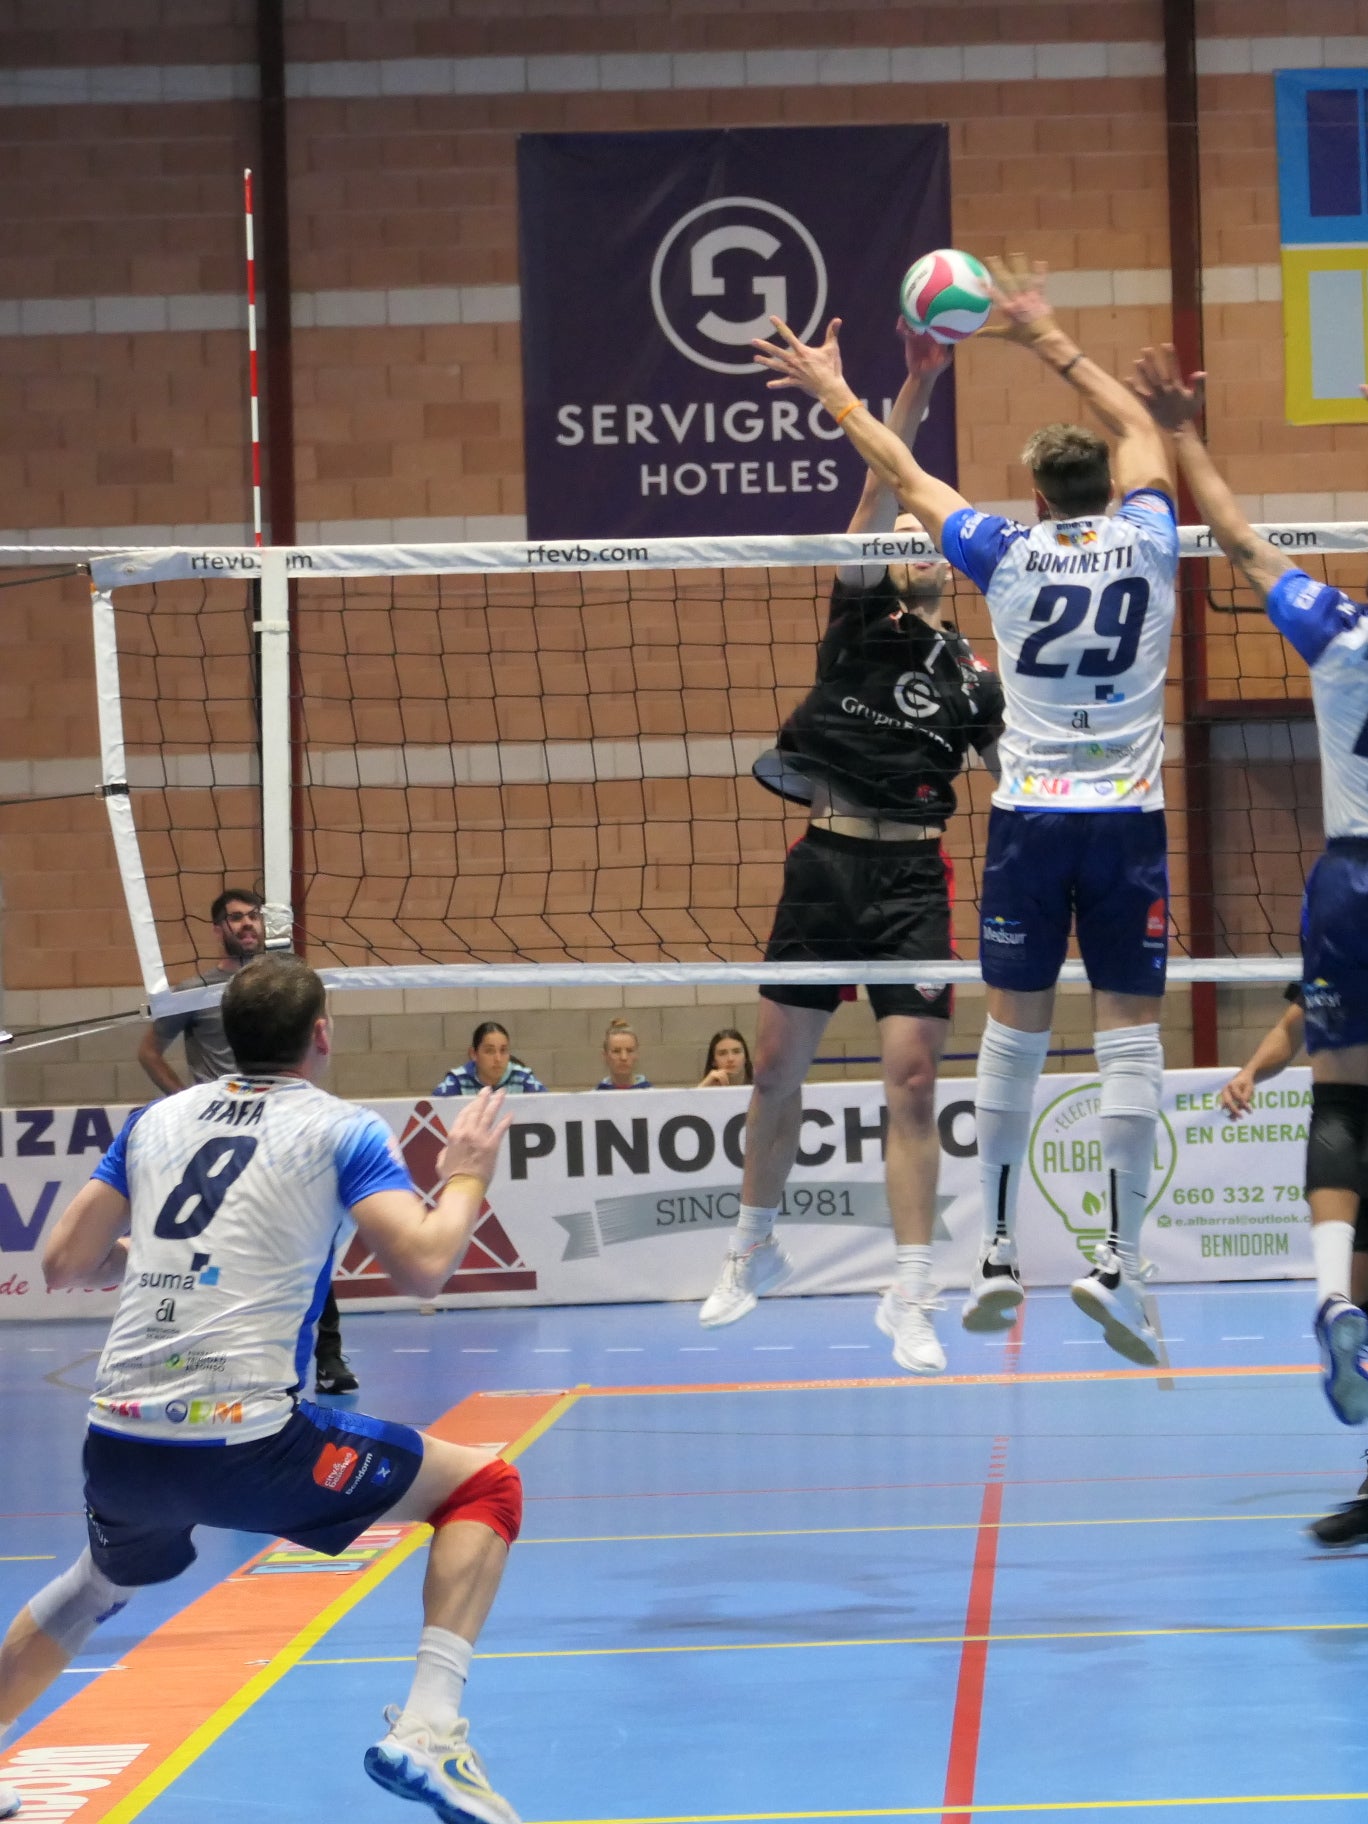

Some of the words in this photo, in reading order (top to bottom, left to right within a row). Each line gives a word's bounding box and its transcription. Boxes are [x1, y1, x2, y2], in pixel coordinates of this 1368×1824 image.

[556, 398, 929, 446] SERVIGRO
[641, 460, 839, 496] HOTELES
[526, 546, 649, 564] rfevb.com
[862, 537, 941, 556] rfevb.
[191, 552, 313, 570] rfevb.m
[1015, 576, 1150, 678] 29
[197, 1100, 266, 1126] RAFA
[1175, 1090, 1315, 1111] ELEICIDA
[509, 1100, 978, 1180] PINOCHO
[1186, 1126, 1214, 1145] EN
[1221, 1124, 1309, 1144] GENERA
[1043, 1140, 1164, 1173] ALBAL
[153, 1135, 259, 1240] 8
[1173, 1187, 1215, 1205] 660
[1223, 1186, 1265, 1204] 332
[656, 1193, 742, 1226] SINC
[778, 1189, 854, 1216] 1981
[1175, 1214, 1312, 1227] e.albarral@outlook.c
[1201, 1232, 1289, 1258] BENIDORM
[139, 1271, 195, 1290] suma
